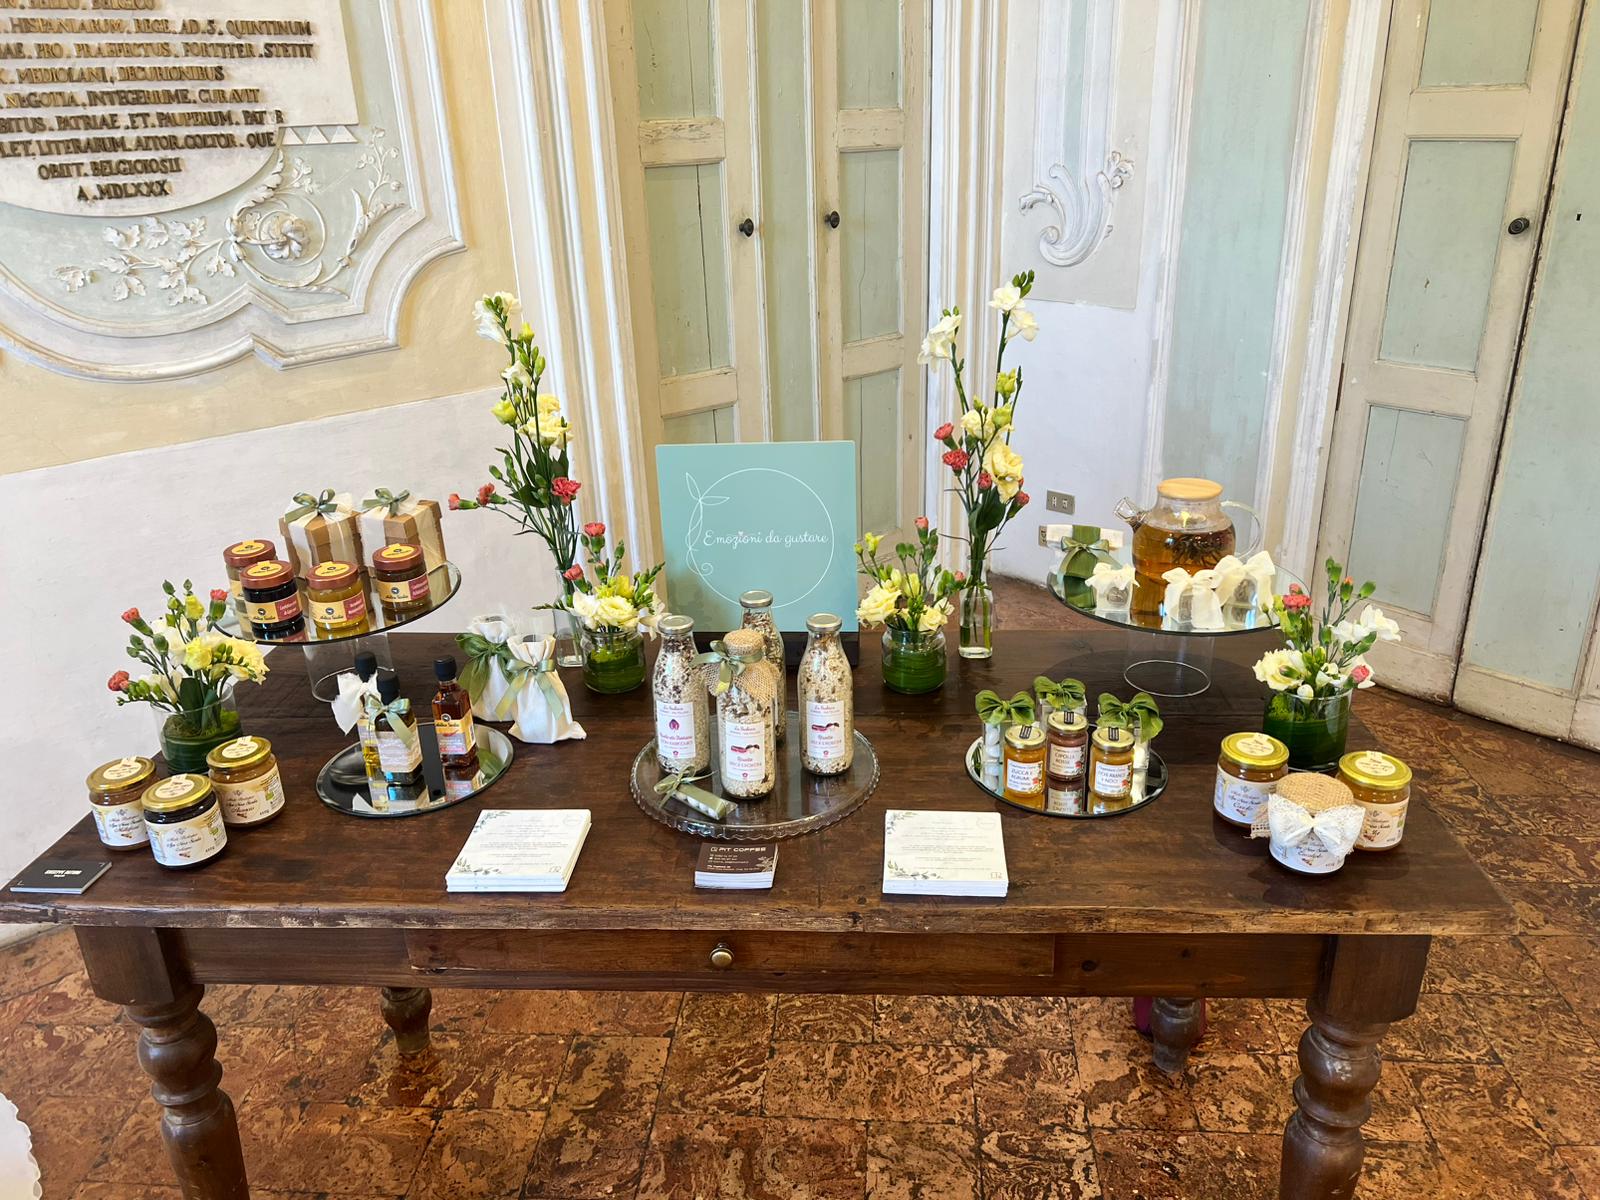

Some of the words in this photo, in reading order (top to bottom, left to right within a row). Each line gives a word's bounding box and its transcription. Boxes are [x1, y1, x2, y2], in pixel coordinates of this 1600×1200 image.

[225, 20, 313, 39] QUINTINUM
[198, 88, 260, 104] CURAVIT
[96, 179, 170, 201] MDLXXX
[703, 530, 763, 549] Emozioni
[765, 529, 783, 544] da
[784, 531, 829, 548] gustare
